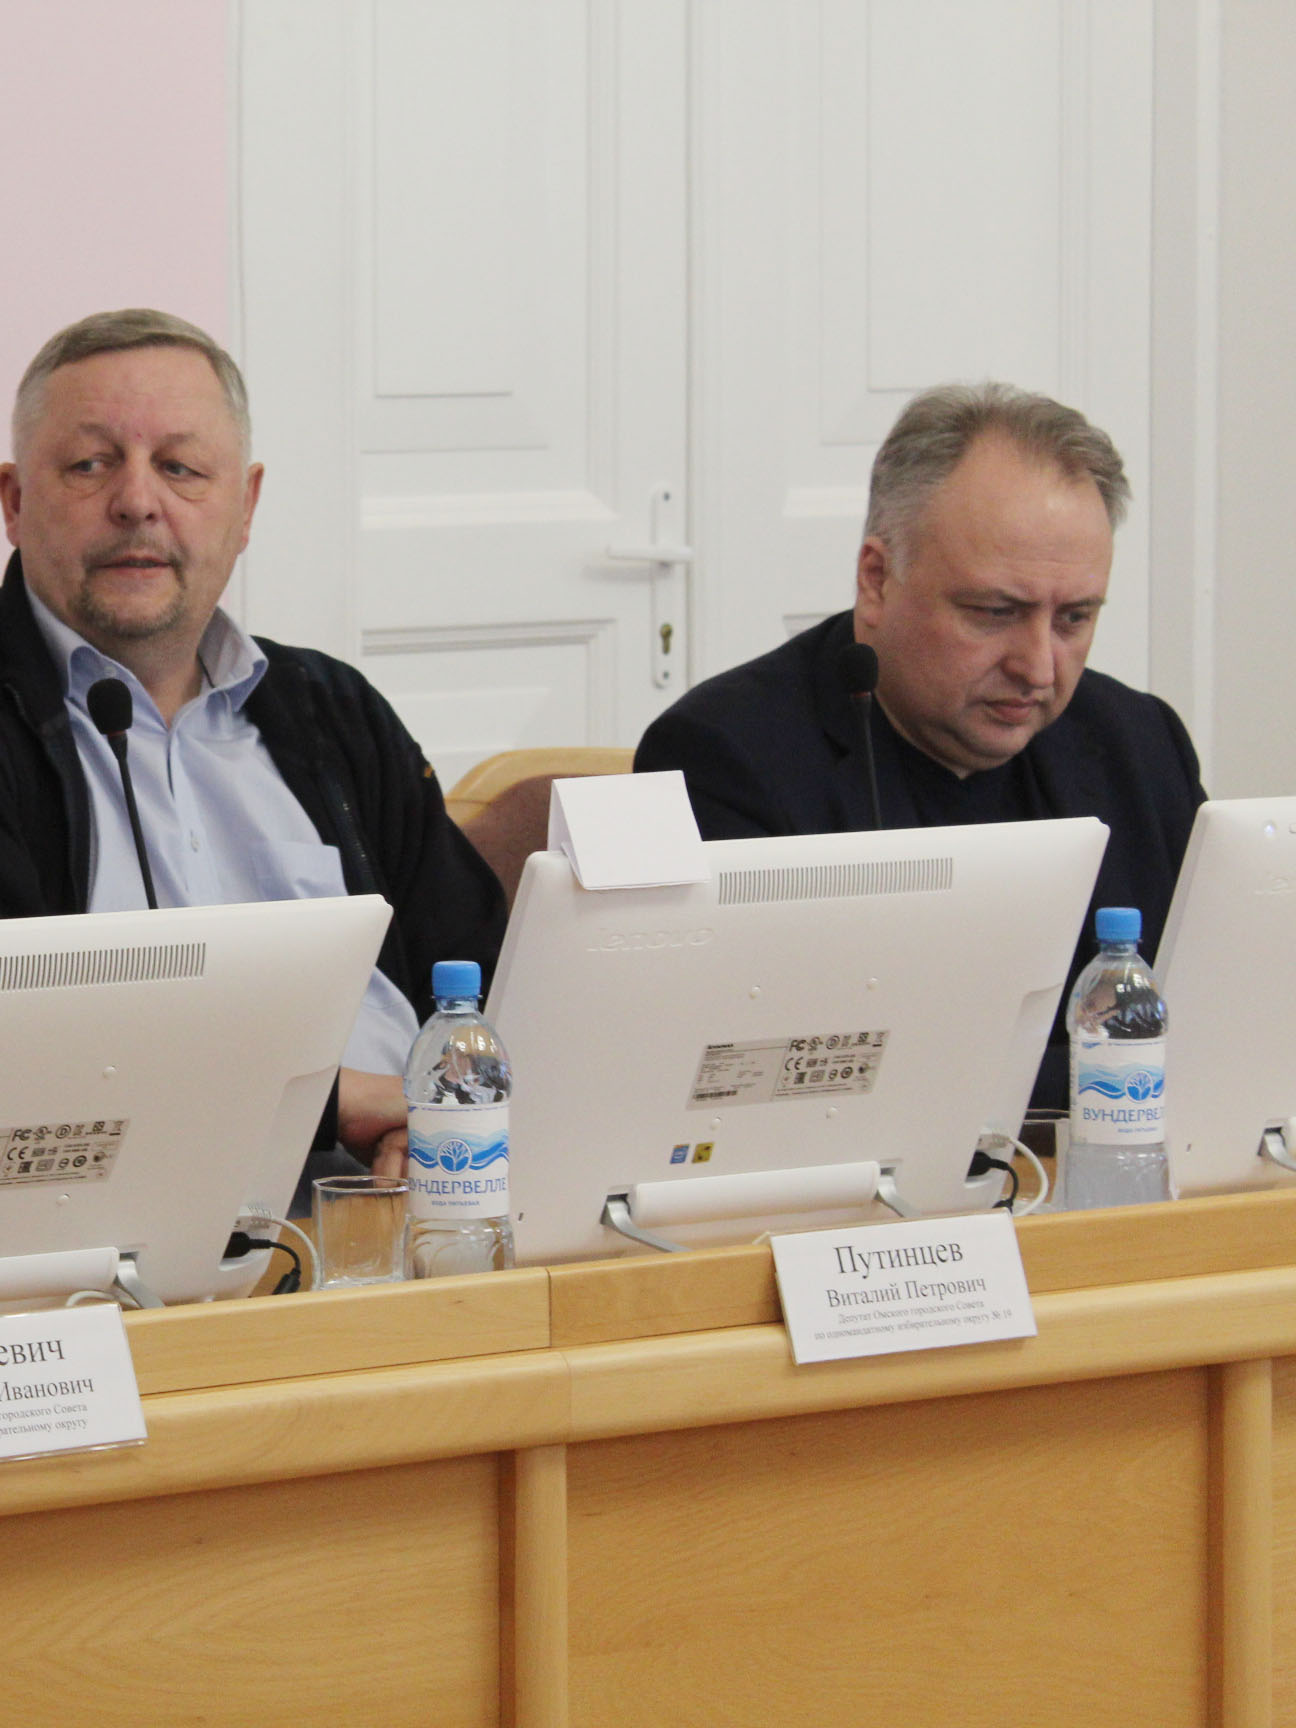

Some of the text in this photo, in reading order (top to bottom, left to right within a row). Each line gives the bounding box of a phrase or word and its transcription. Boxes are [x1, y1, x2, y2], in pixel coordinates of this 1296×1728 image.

[833, 1242, 964, 1279] Путинцев
[825, 1277, 987, 1308] Виталий Петрович
[54, 1402, 88, 1414] Совета
[55, 1417, 88, 1430] округу
